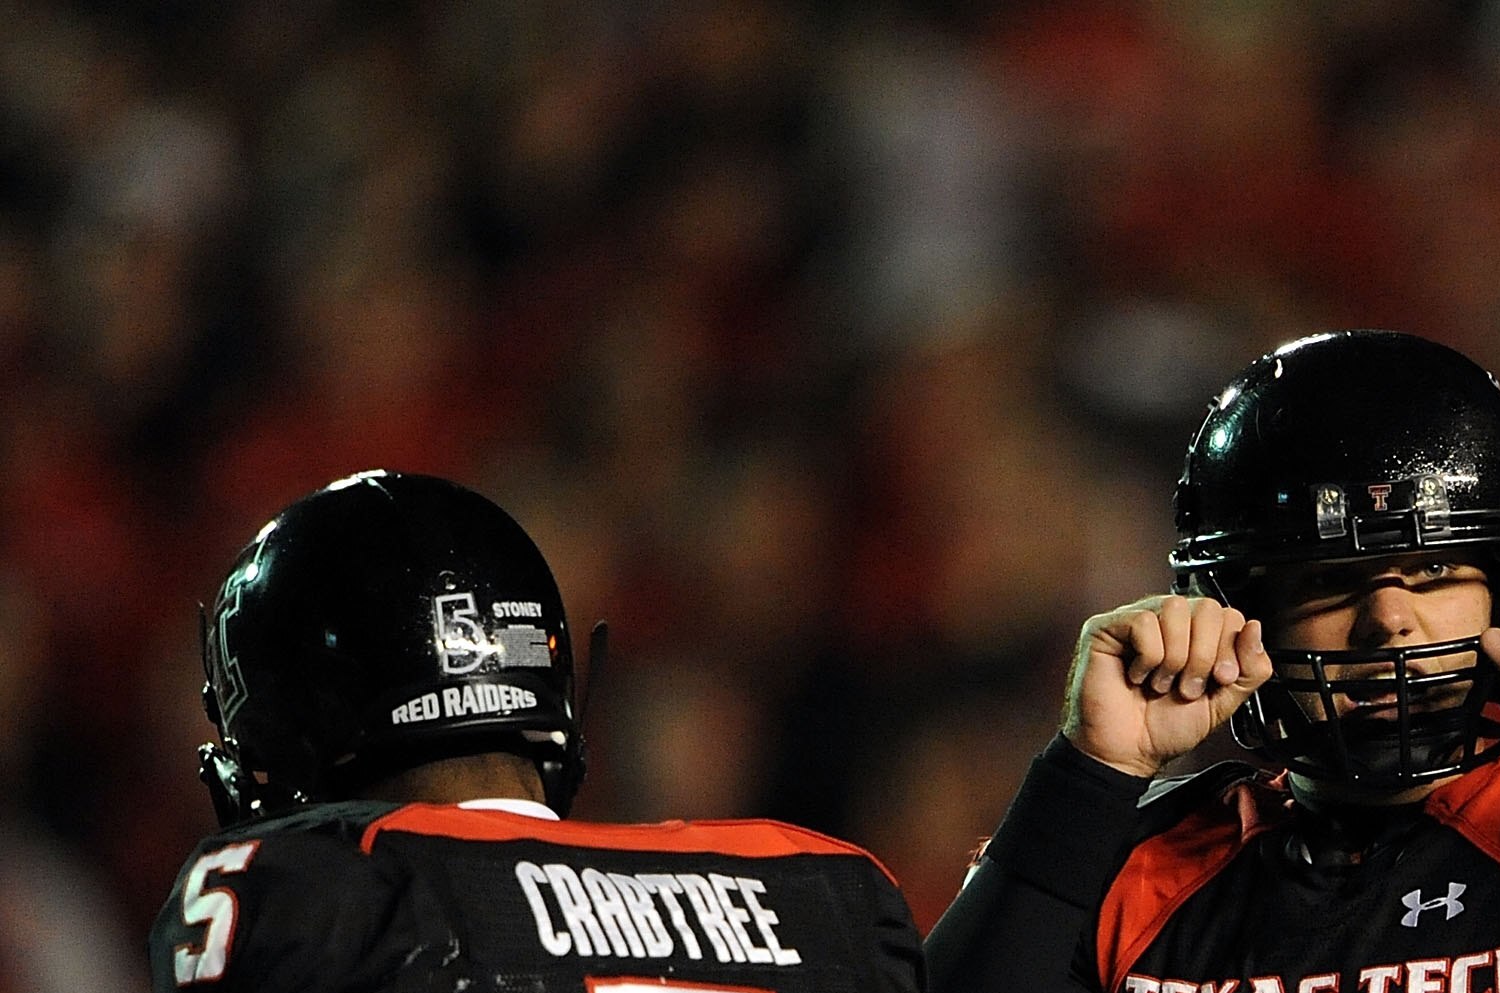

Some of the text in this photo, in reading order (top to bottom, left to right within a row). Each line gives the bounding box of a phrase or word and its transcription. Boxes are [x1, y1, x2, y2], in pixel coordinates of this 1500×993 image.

[435, 592, 488, 674] 5
[492, 602, 542, 618] STONEY
[392, 683, 538, 724] RED RAIDERS
[174, 840, 263, 987] 5
[515, 861, 802, 965] CRABTREE
